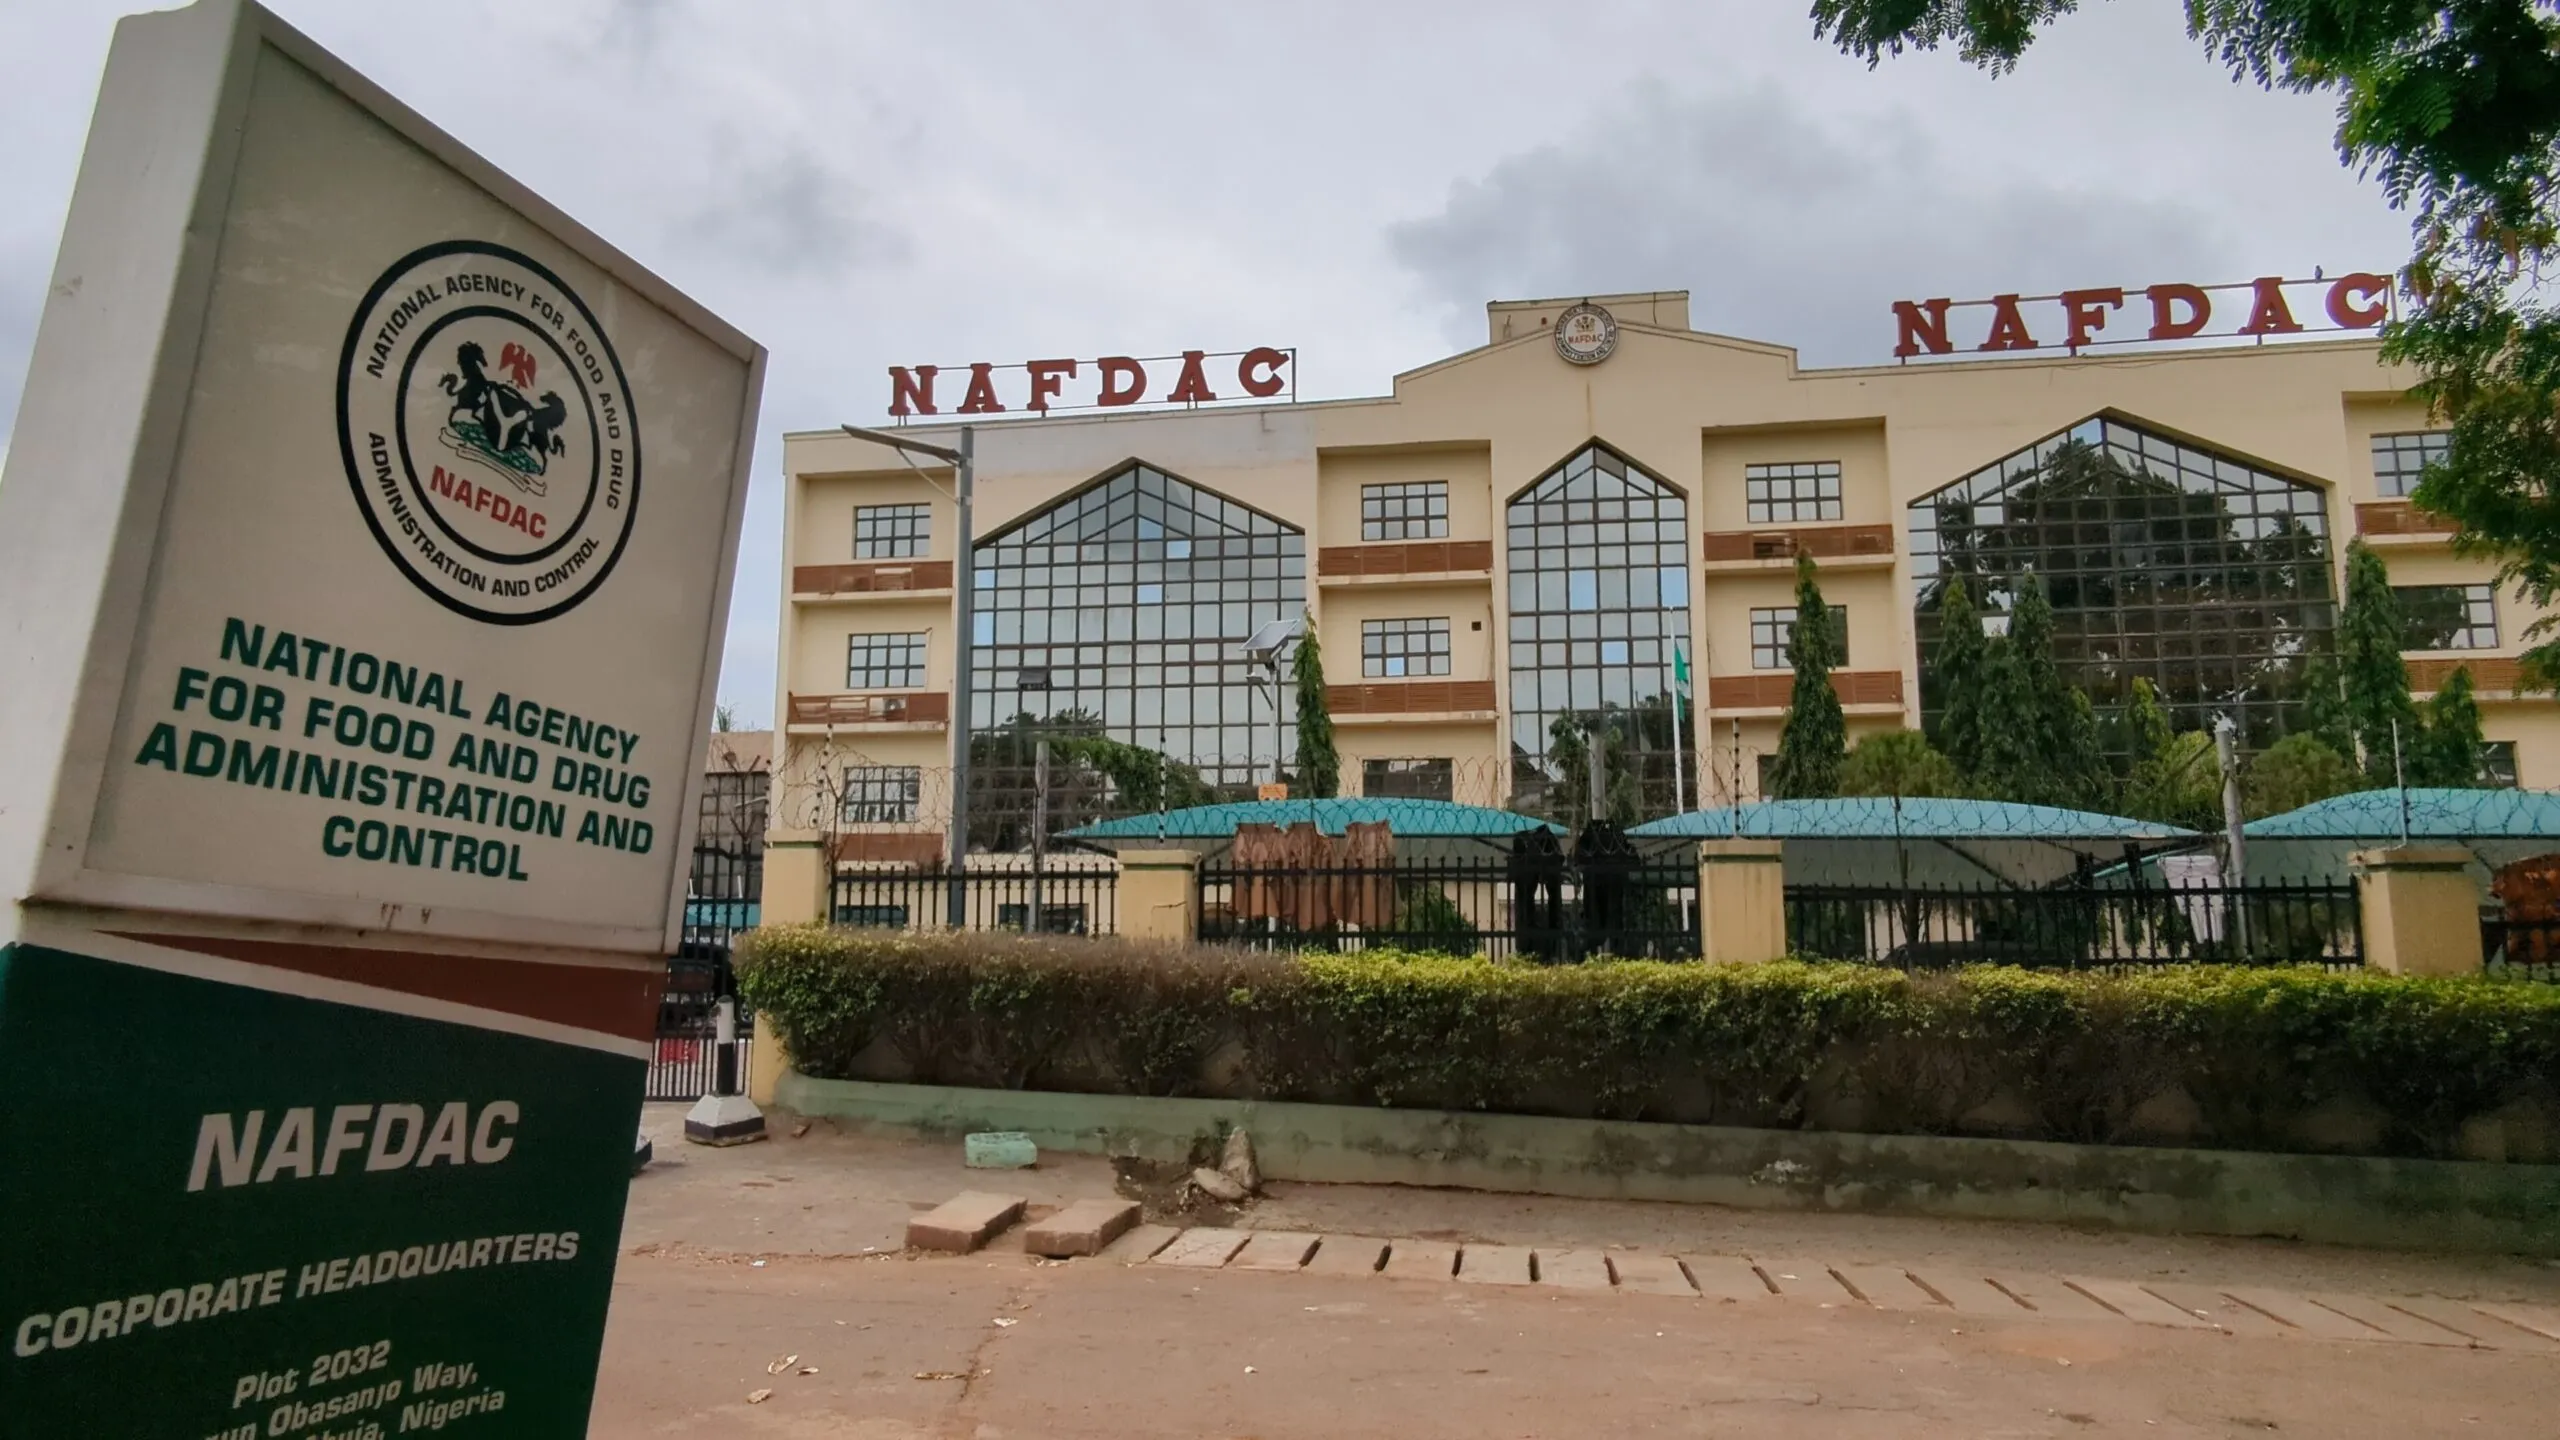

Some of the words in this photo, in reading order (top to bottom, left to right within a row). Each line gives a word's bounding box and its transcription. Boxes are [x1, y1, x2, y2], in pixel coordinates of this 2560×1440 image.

[446, 274, 526, 302] AGENCY
[530, 294, 565, 331] FOR
[1892, 272, 2391, 357] NAFDAC
[366, 284, 442, 379] NATIONAL
[566, 328, 604, 385] FOOD
[599, 392, 621, 440] AND
[888, 347, 1290, 416] NAFDAC
[369, 431, 486, 593] ADMINISTRATION
[491, 578, 531, 597] AND
[535, 536, 600, 592] CONTROL
[430, 465, 548, 539] NAFDAC
[606, 449, 624, 510] DRUG
[219, 617, 472, 719] NATIONAL
[485, 692, 640, 764] AGENCY
[172, 666, 287, 732] FOR
[304, 696, 435, 762] FOOD
[448, 733, 539, 784] AND
[552, 757, 651, 809] DRUG
[135, 721, 566, 839] ADMINISTRATION
[576, 810, 654, 855] AND
[321, 814, 529, 882] CONTROL
[186, 1100, 520, 1193] NAFDAC
[14, 1268, 287, 1358] CORPORATE
[296, 1231, 580, 1299] HEADQUARTERS
[232, 1368, 300, 1409] Plot
[308, 1339, 391, 1387] 2032
[268, 1379, 403, 1437] Obasanjo
[412, 1361, 478, 1394] Way,
[399, 1386, 506, 1433] Nigeria
